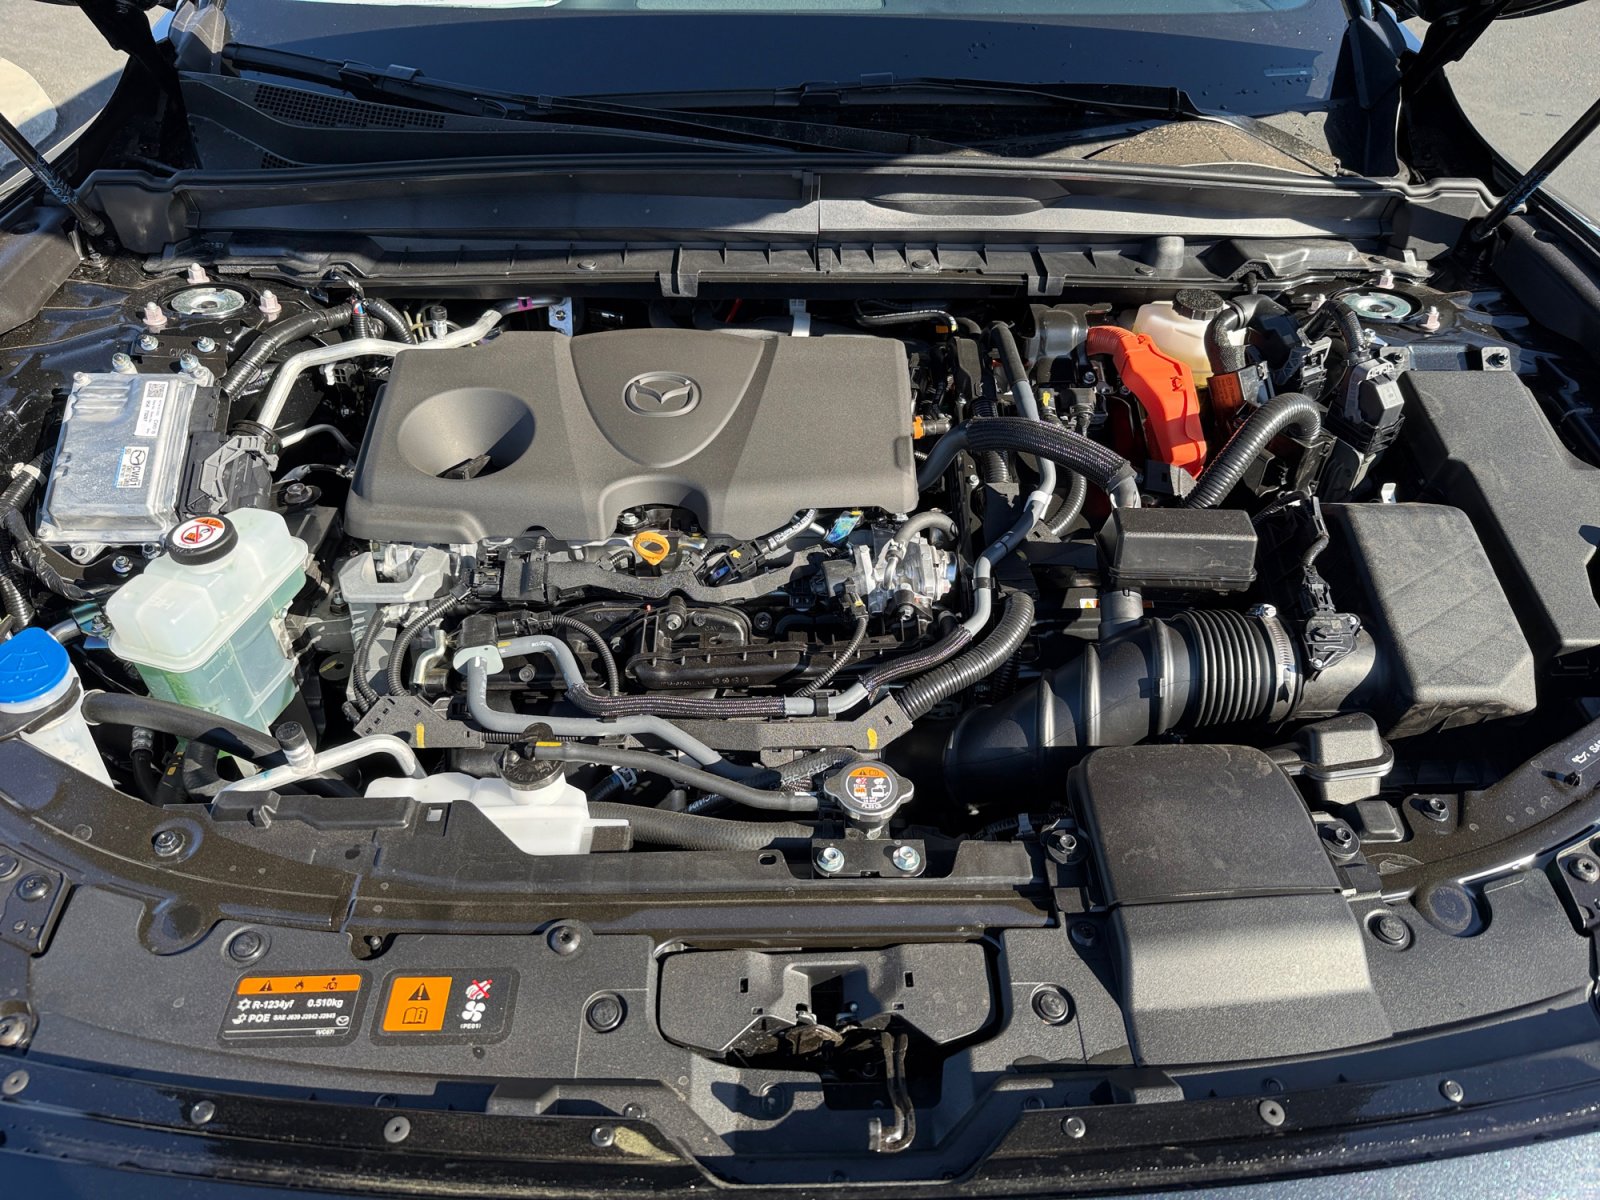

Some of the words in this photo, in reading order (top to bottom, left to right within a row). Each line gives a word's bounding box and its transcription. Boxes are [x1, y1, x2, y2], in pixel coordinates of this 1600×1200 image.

[252, 1000, 295, 1010] R-1234yf
[307, 999, 344, 1008] 0.510kg
[247, 1013, 271, 1023] POE
